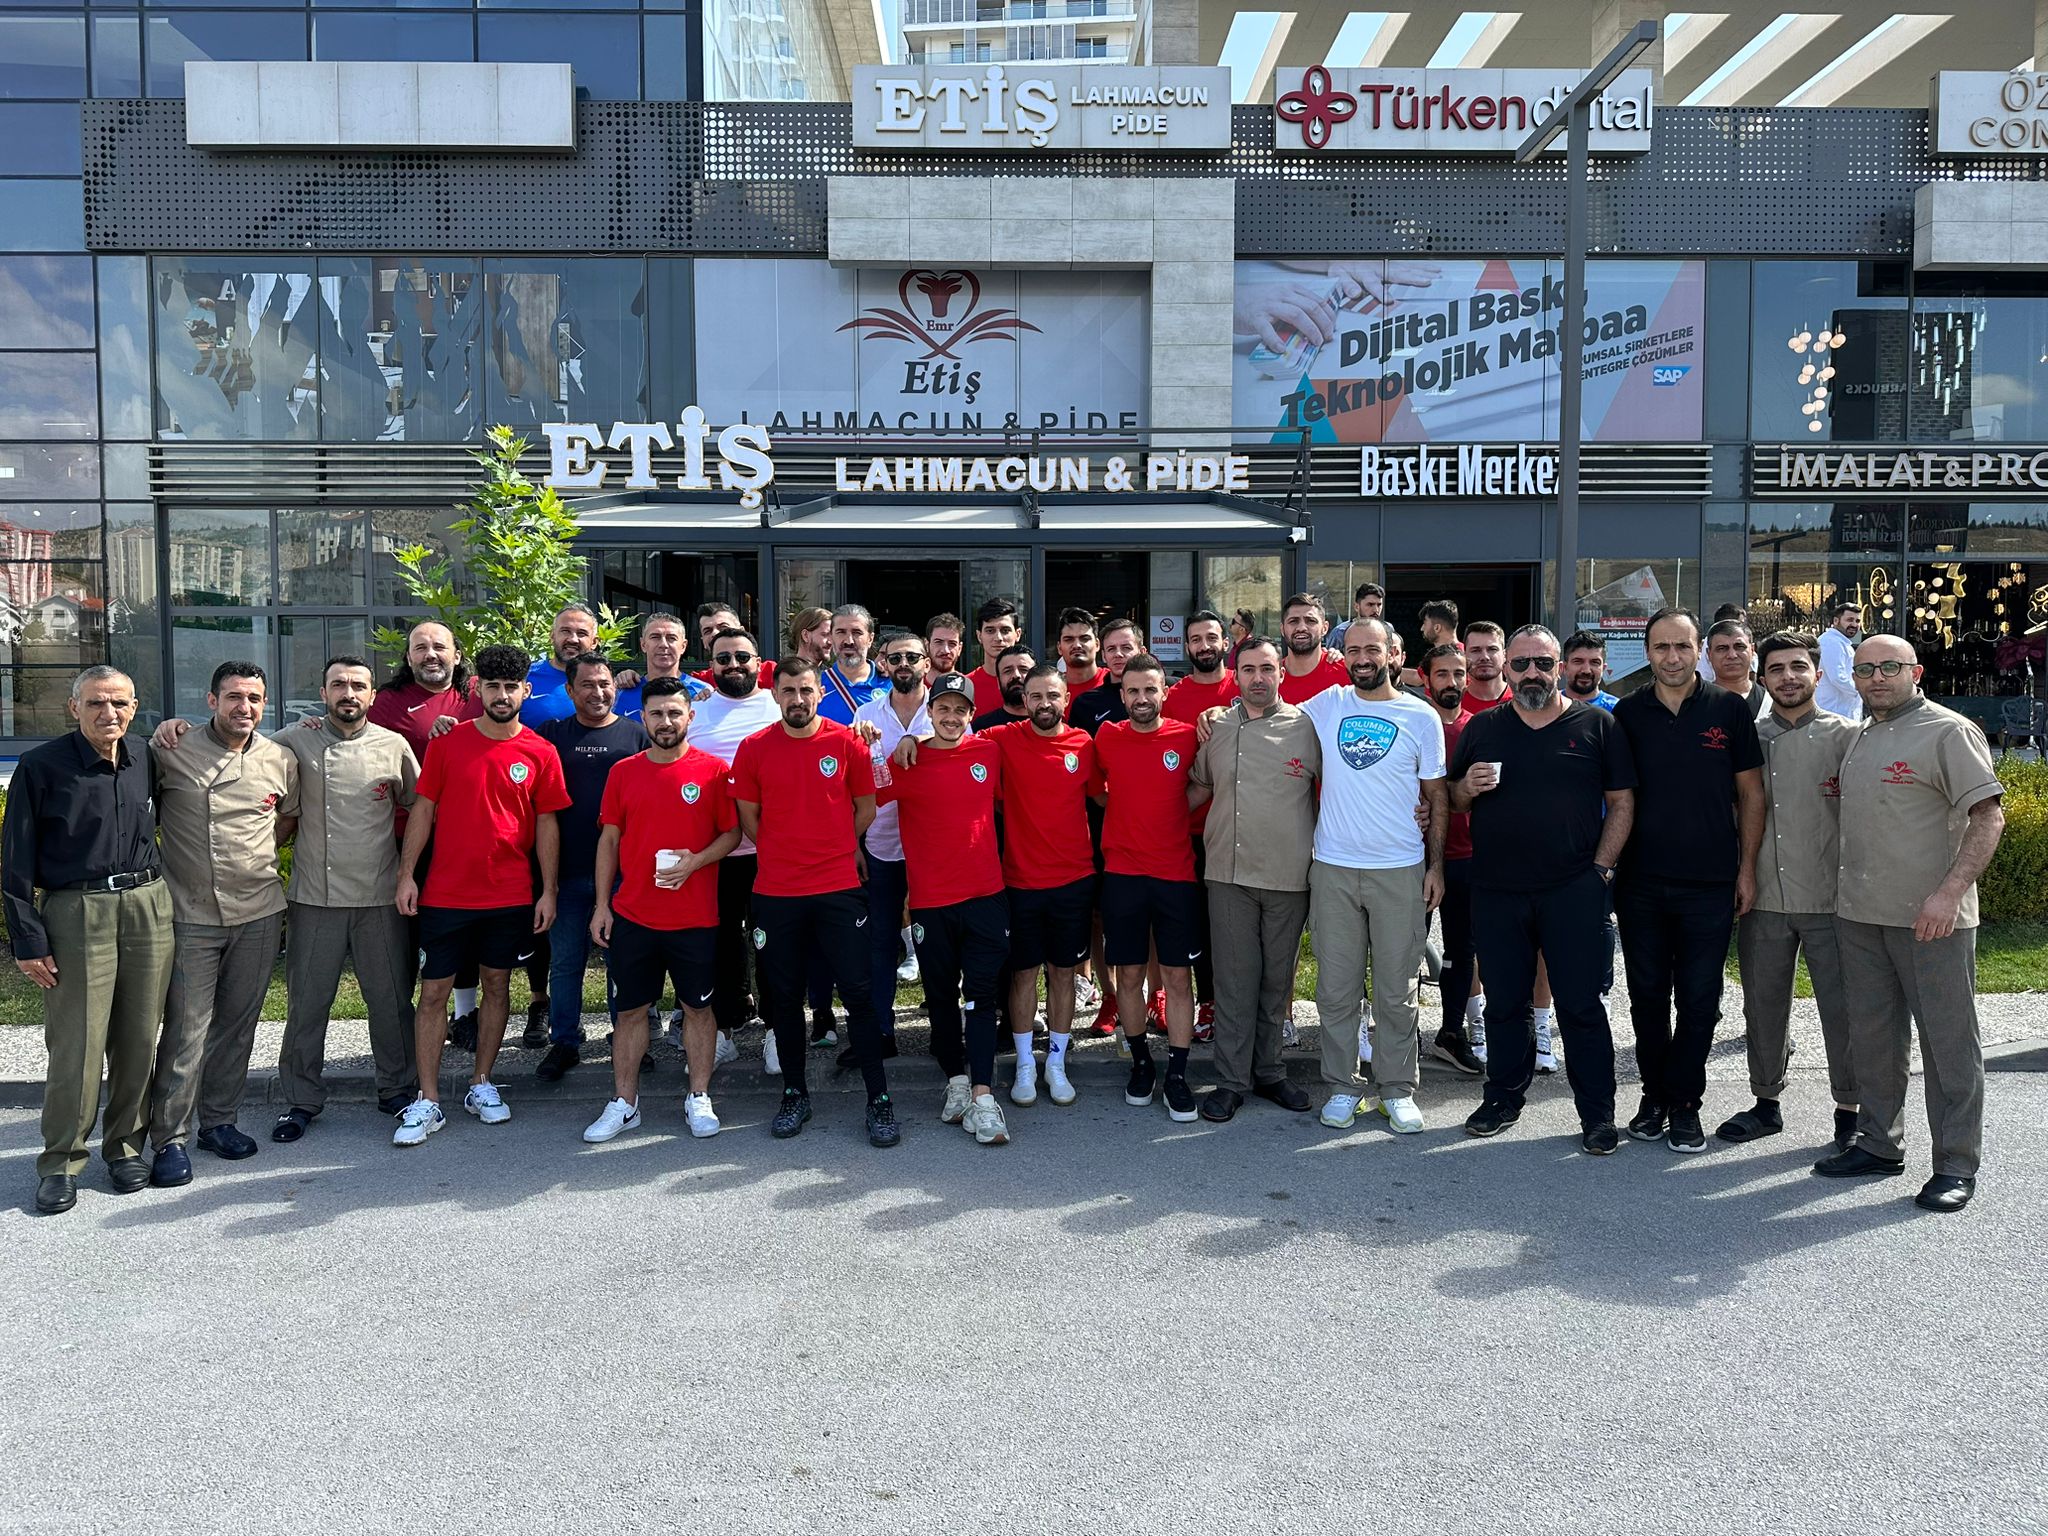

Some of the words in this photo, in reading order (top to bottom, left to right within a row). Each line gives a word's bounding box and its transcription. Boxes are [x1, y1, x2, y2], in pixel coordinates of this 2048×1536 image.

[875, 64, 1059, 148] ETİŞ
[1071, 86, 1209, 107] LAHMACUN
[1111, 110, 1168, 134] PİDE
[926, 319, 955, 332] Emr
[1340, 300, 1459, 368] Dijital
[1632, 341, 1694, 367] ÇÖZÜMLER
[900, 361, 982, 404] Etiş
[1280, 341, 1491, 428] Teknolojik
[1653, 369, 1683, 383] SAP
[1040, 406, 1138, 437] PİDE
[541, 405, 776, 509] ETİŞ
[834, 456, 1090, 492] LAHMACUN
[1104, 456, 1134, 491] &
[1147, 449, 1251, 491] PİDE
[1361, 444, 1447, 497] Baskı
[1344, 731, 1354, 739] 19
[1378, 736, 1390, 744] 38
[1345, 720, 1393, 735] COLUMBIA
